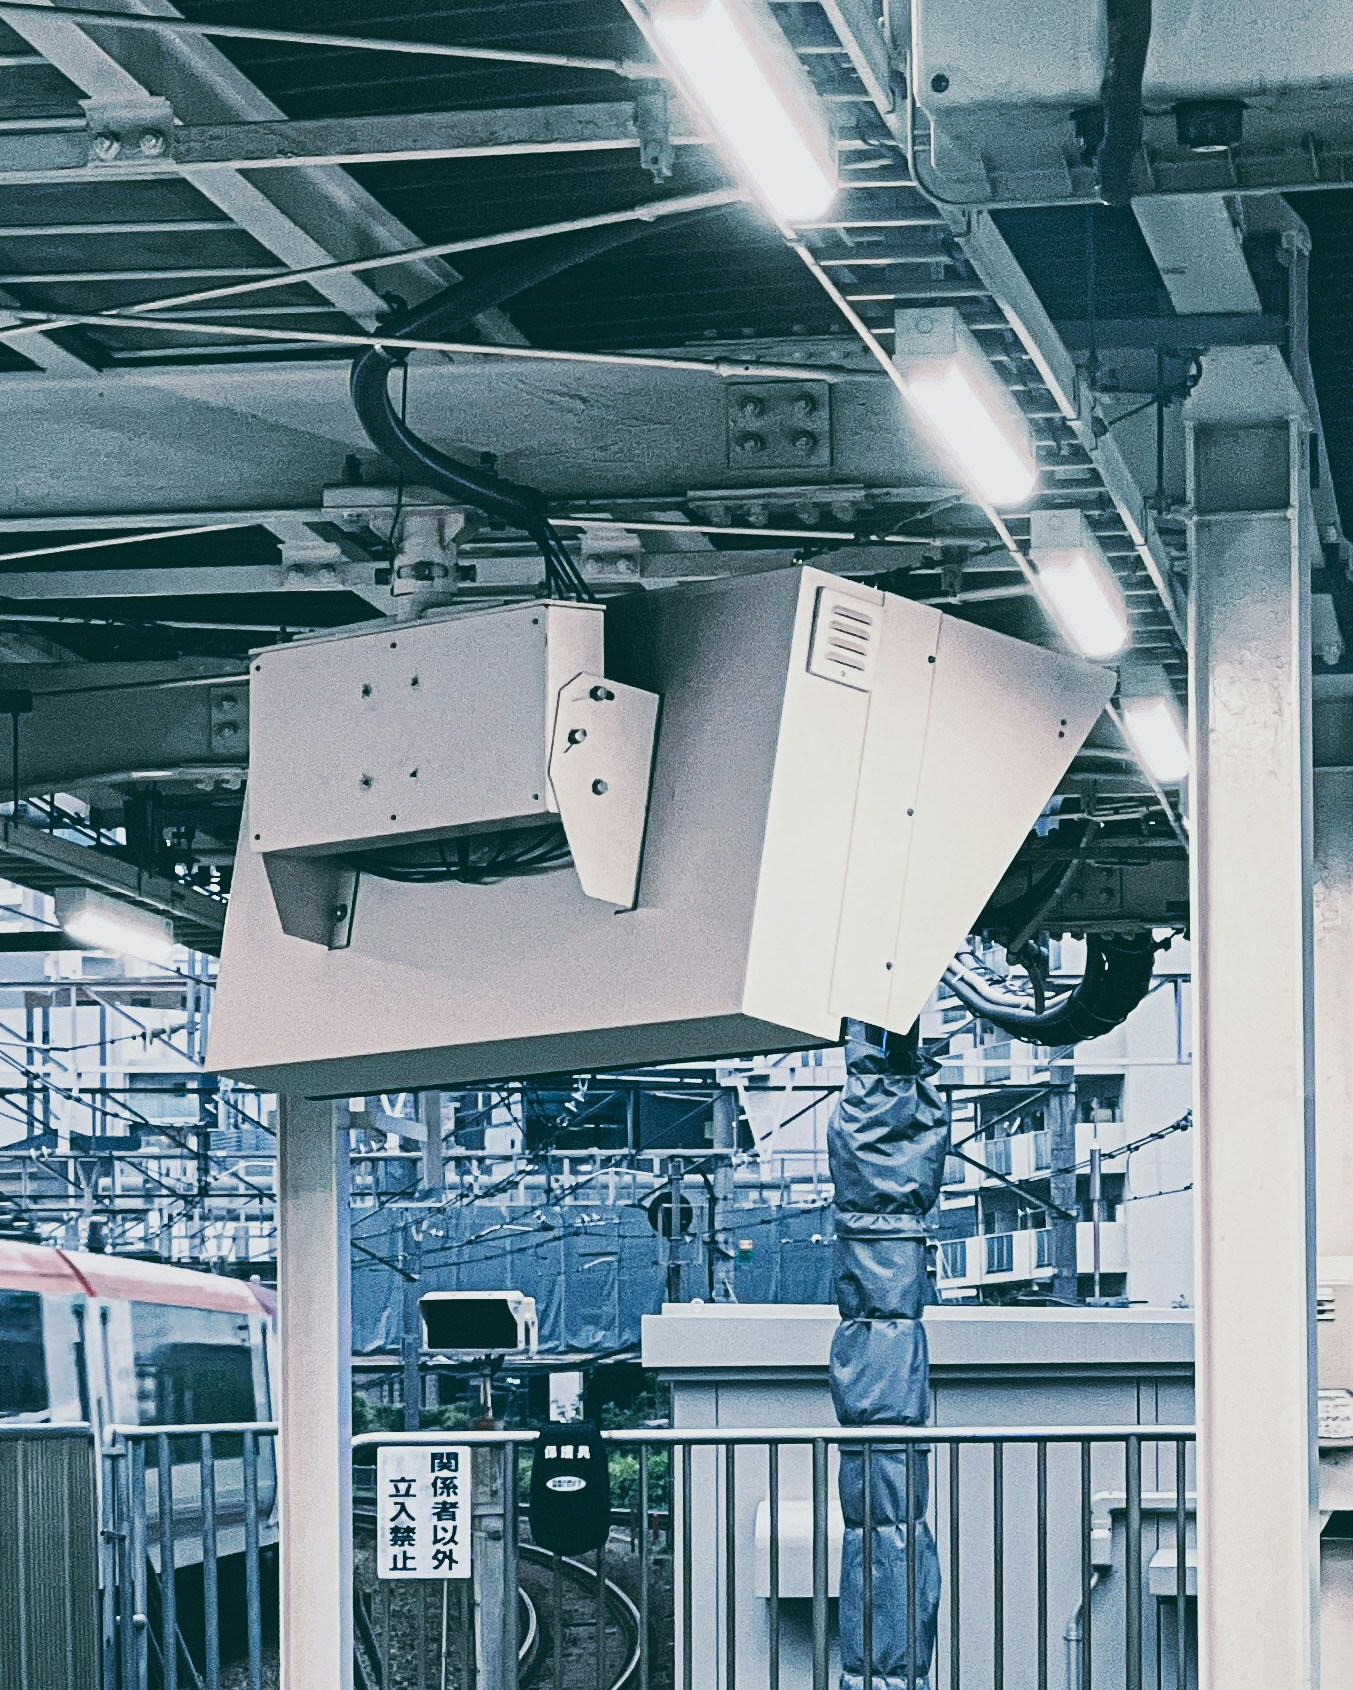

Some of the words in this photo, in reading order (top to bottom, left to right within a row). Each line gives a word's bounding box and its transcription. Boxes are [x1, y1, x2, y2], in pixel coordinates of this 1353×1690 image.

[388, 1476, 417, 1572] 立入禁止
[430, 1451, 460, 1571] 関係者以外
